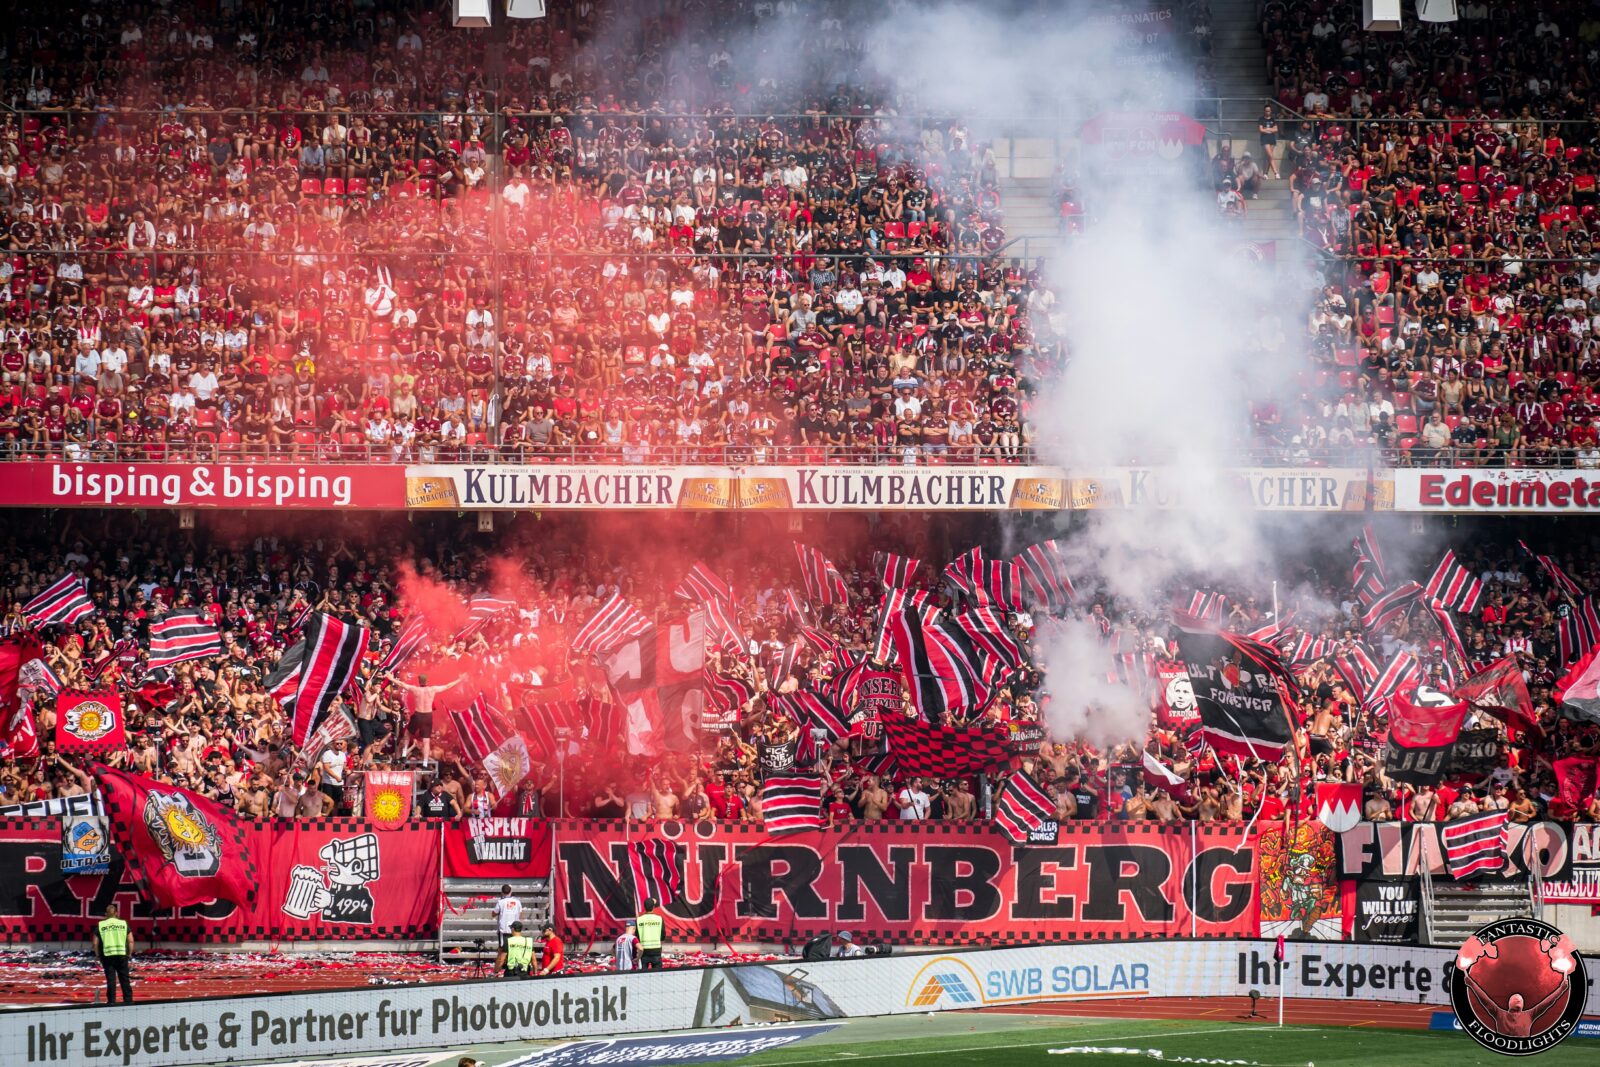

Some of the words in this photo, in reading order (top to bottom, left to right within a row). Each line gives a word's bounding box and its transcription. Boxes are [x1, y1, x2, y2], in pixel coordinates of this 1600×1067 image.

[52, 465, 181, 504] bisping
[189, 467, 216, 496] &
[223, 467, 351, 505] bisping
[464, 468, 674, 504] KULMBACHER
[797, 470, 1006, 505] KULMBACHER
[766, 746, 788, 754] FICK
[771, 752, 786, 760] DIE
[468, 817, 529, 837] RESPEKT
[1030, 832, 1055, 841] JUNGS
[557, 820, 1254, 924] NÜRNBERG
[1378, 887, 1404, 900] YOU
[336, 898, 368, 914] 1994
[1362, 901, 1392, 914] WILL
[1362, 911, 1414, 931] forever
[986, 968, 1042, 997] SWB
[1051, 963, 1149, 992] SOLAR
[1238, 951, 1290, 985] Ihr
[1301, 955, 1432, 996] Experte
[28, 1022, 73, 1062] Ihr
[84, 1018, 208, 1066] Experte
[218, 1012, 241, 1048] &
[251, 1009, 369, 1046] Partner
[376, 999, 422, 1037] fur
[432, 985, 627, 1034] Photovoltaik!
